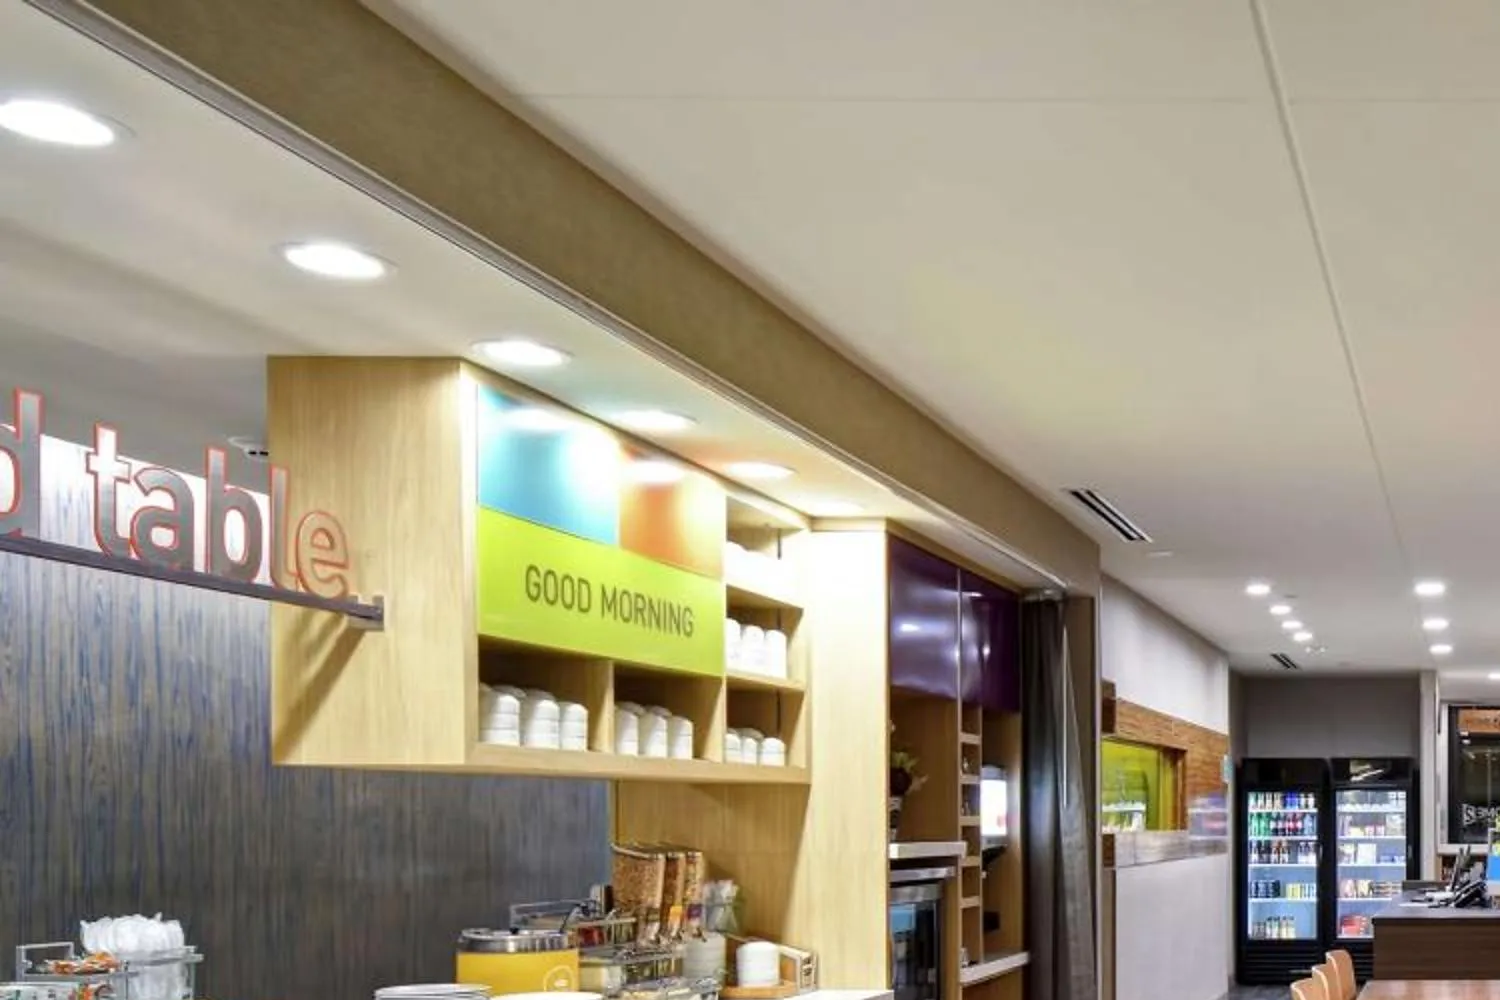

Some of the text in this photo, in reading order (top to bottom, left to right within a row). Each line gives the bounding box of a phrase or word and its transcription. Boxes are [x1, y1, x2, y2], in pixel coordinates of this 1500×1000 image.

[86, 423, 348, 598] table
[525, 564, 694, 637] GOOD MORNING
